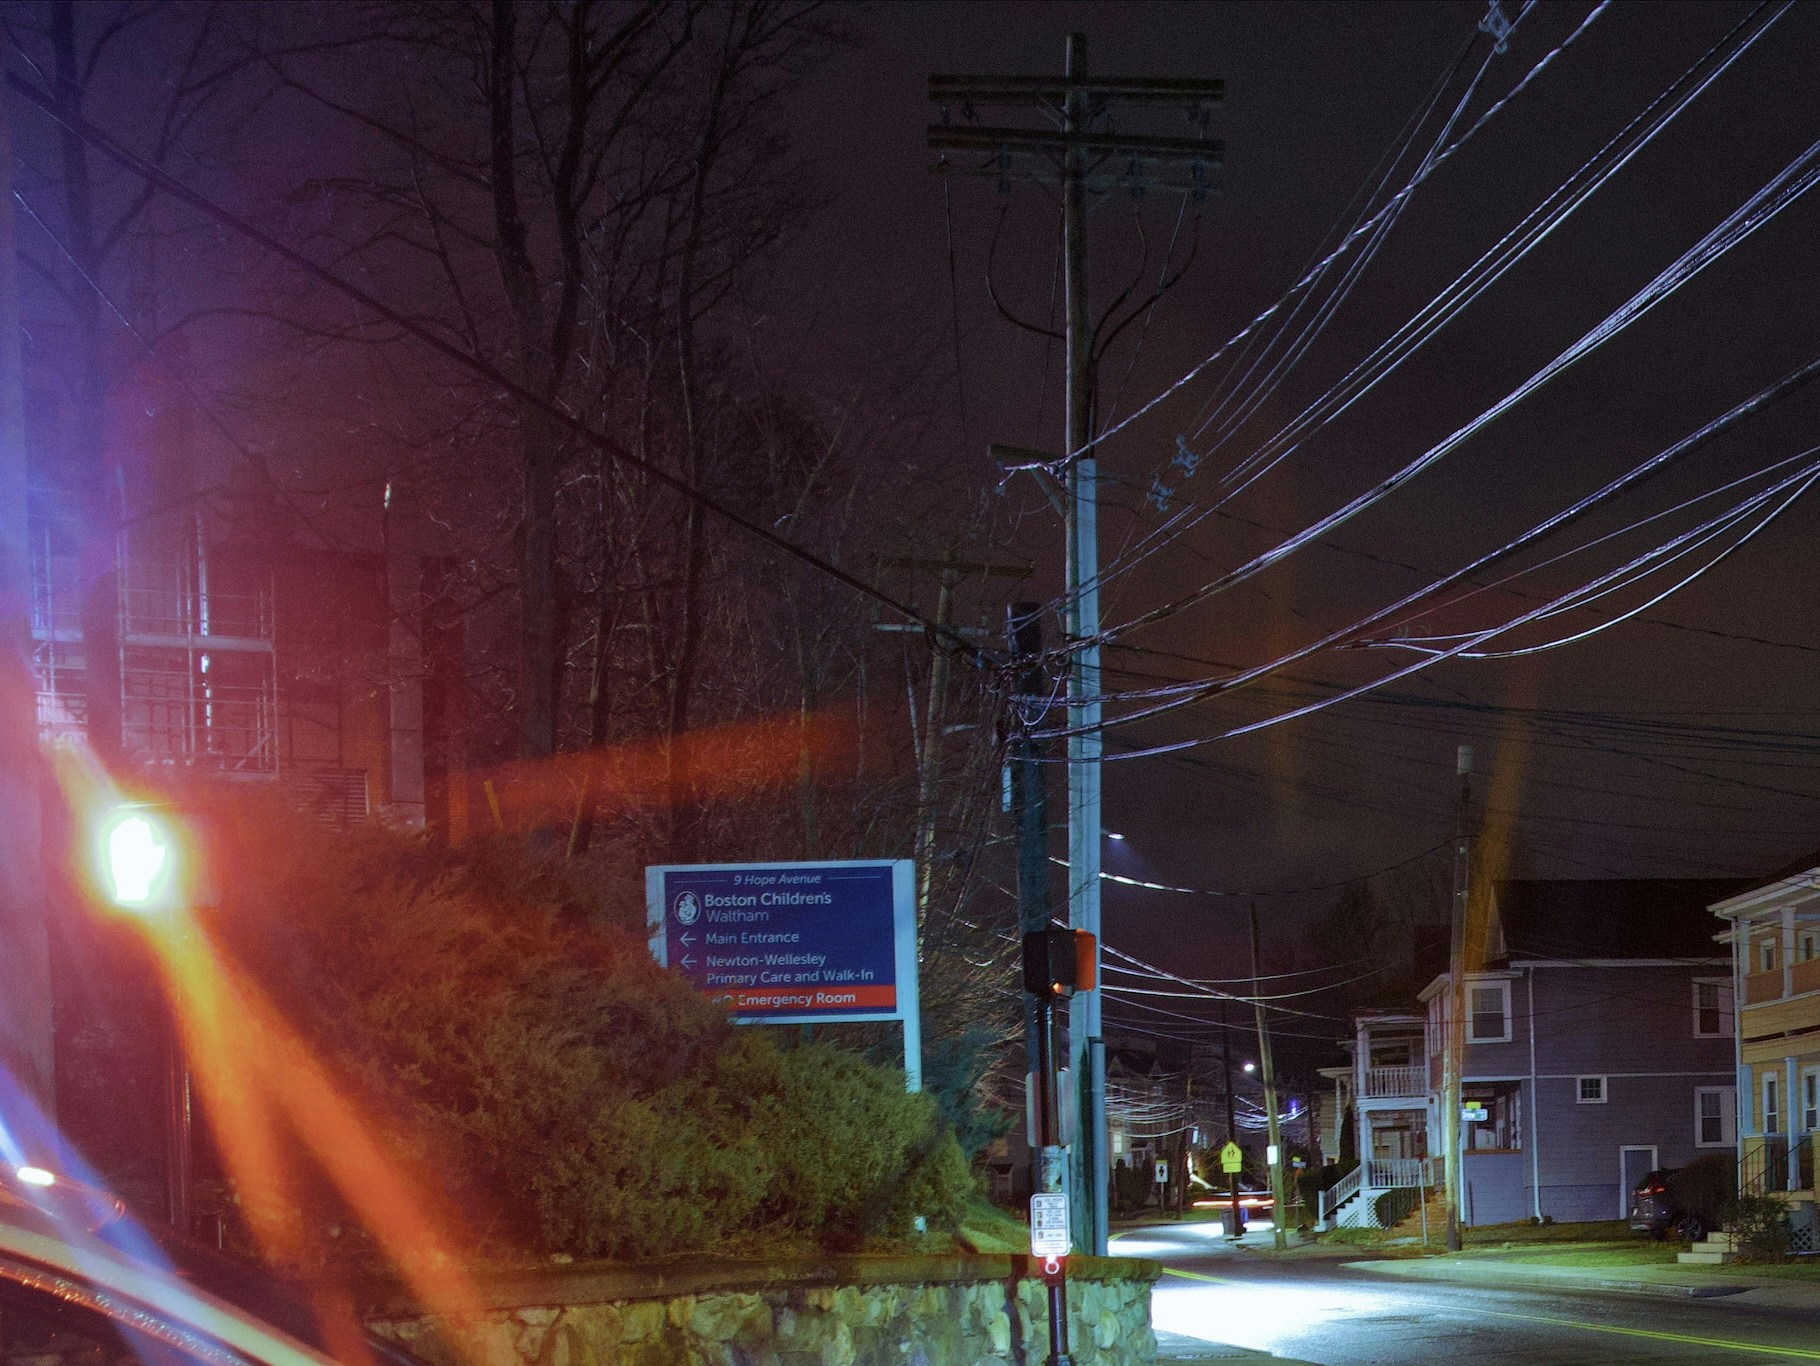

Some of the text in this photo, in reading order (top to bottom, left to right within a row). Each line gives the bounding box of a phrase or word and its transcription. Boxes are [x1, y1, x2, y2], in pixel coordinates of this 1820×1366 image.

[734, 874, 822, 887] 9 Hope Avenue
[704, 891, 832, 907] Boston Children's
[706, 909, 769, 923] Waltham
[705, 931, 799, 945] Main Entrance
[706, 953, 827, 967] Newton-Wellesley
[706, 968, 874, 986] Primary Care and Walk-In
[738, 993, 812, 1008] Emergency
[816, 992, 856, 1004] Room
